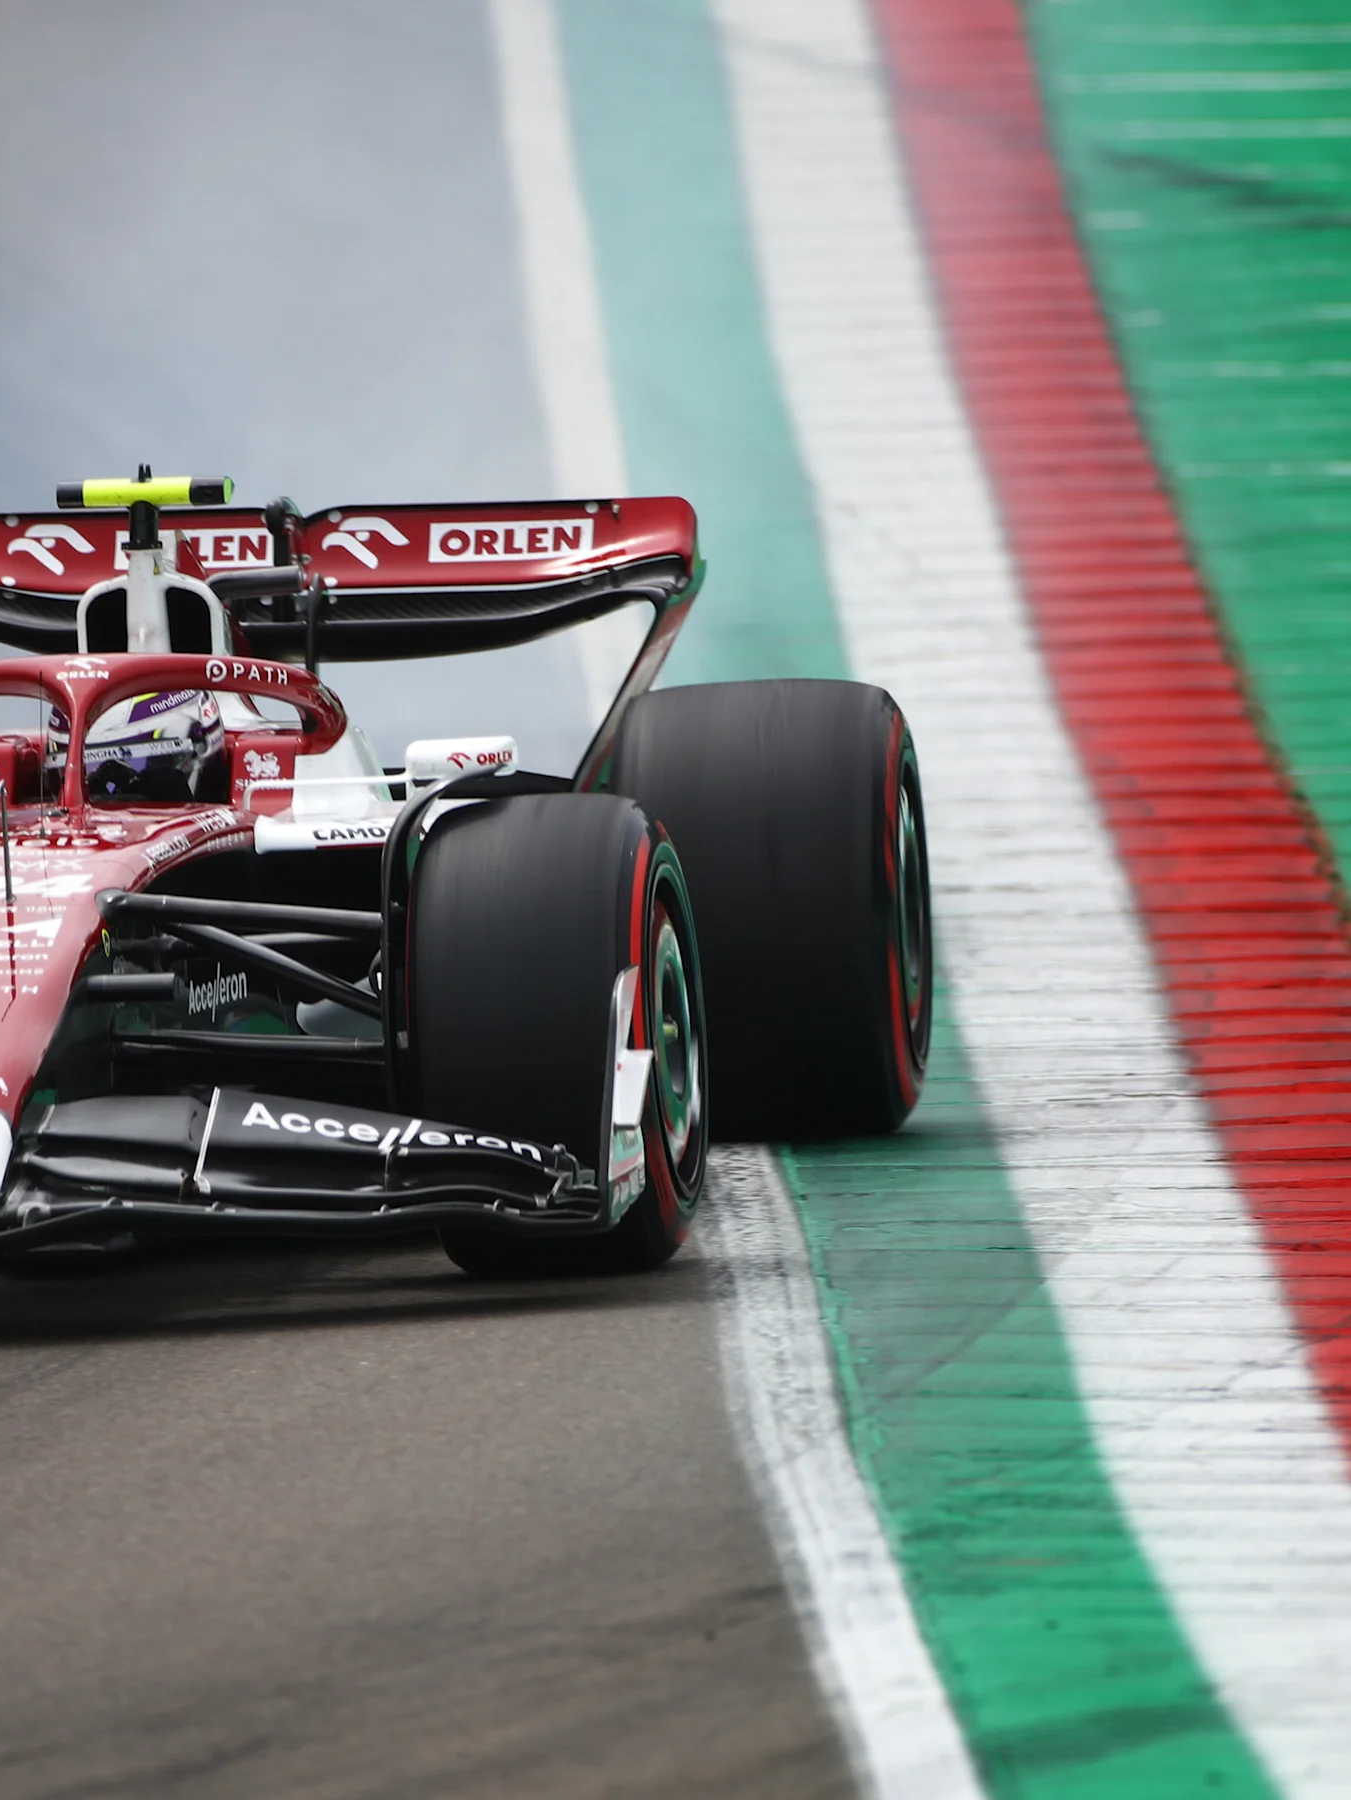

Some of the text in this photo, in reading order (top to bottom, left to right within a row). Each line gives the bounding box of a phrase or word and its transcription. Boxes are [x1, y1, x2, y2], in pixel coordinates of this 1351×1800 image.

[439, 526, 582, 556] ORLEN
[56, 670, 110, 680] ORLEN
[233, 662, 289, 686] PATH
[242, 1102, 543, 1162] Accelleron
